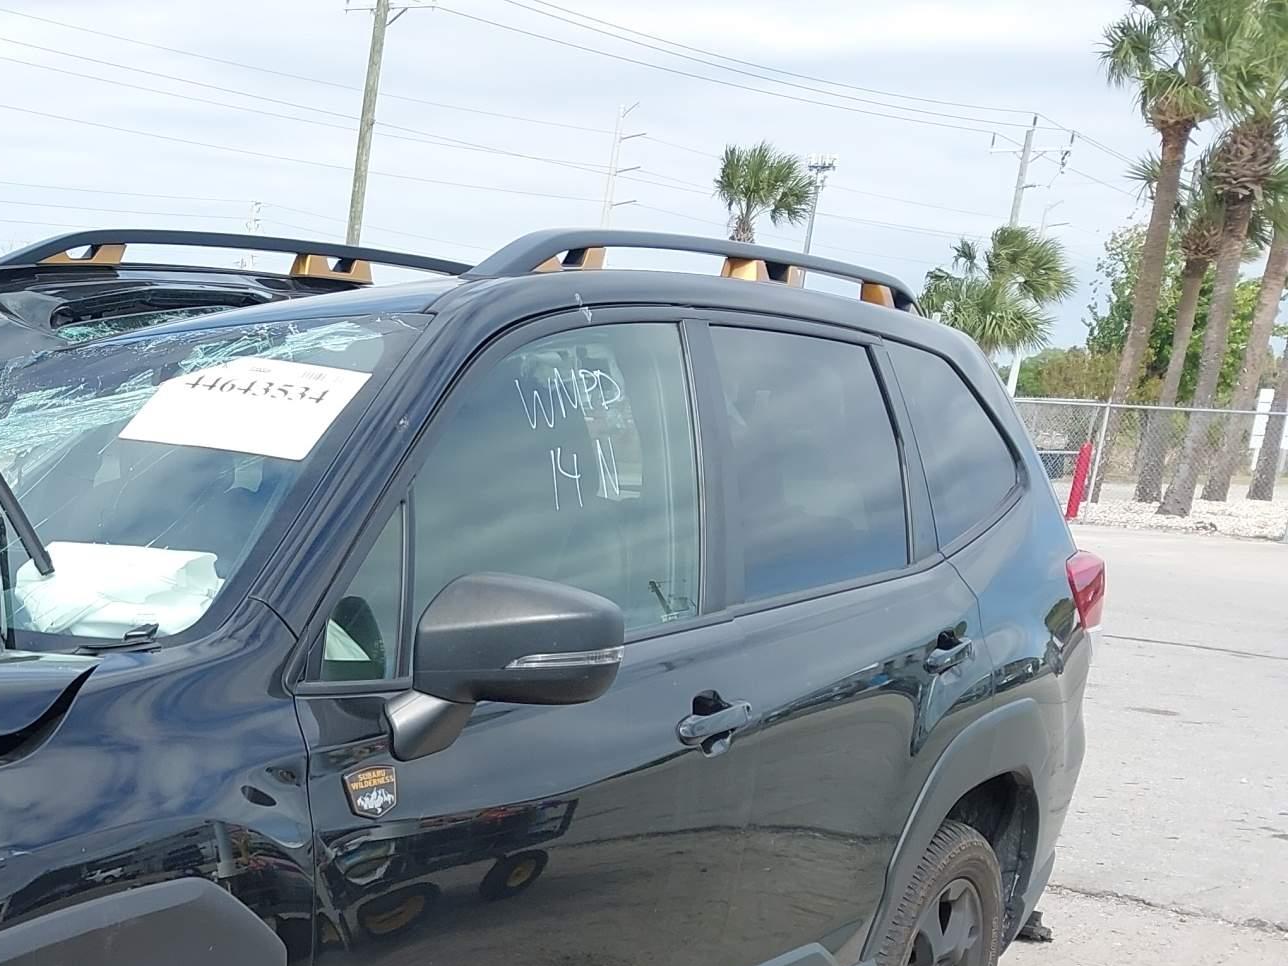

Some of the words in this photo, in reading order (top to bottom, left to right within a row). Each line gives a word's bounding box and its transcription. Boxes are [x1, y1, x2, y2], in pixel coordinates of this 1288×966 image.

[185, 374, 330, 404] 44643534
[550, 447, 584, 511] 14
[351, 775, 394, 790] WILDERNESS
[358, 769, 386, 780] SUBARU
